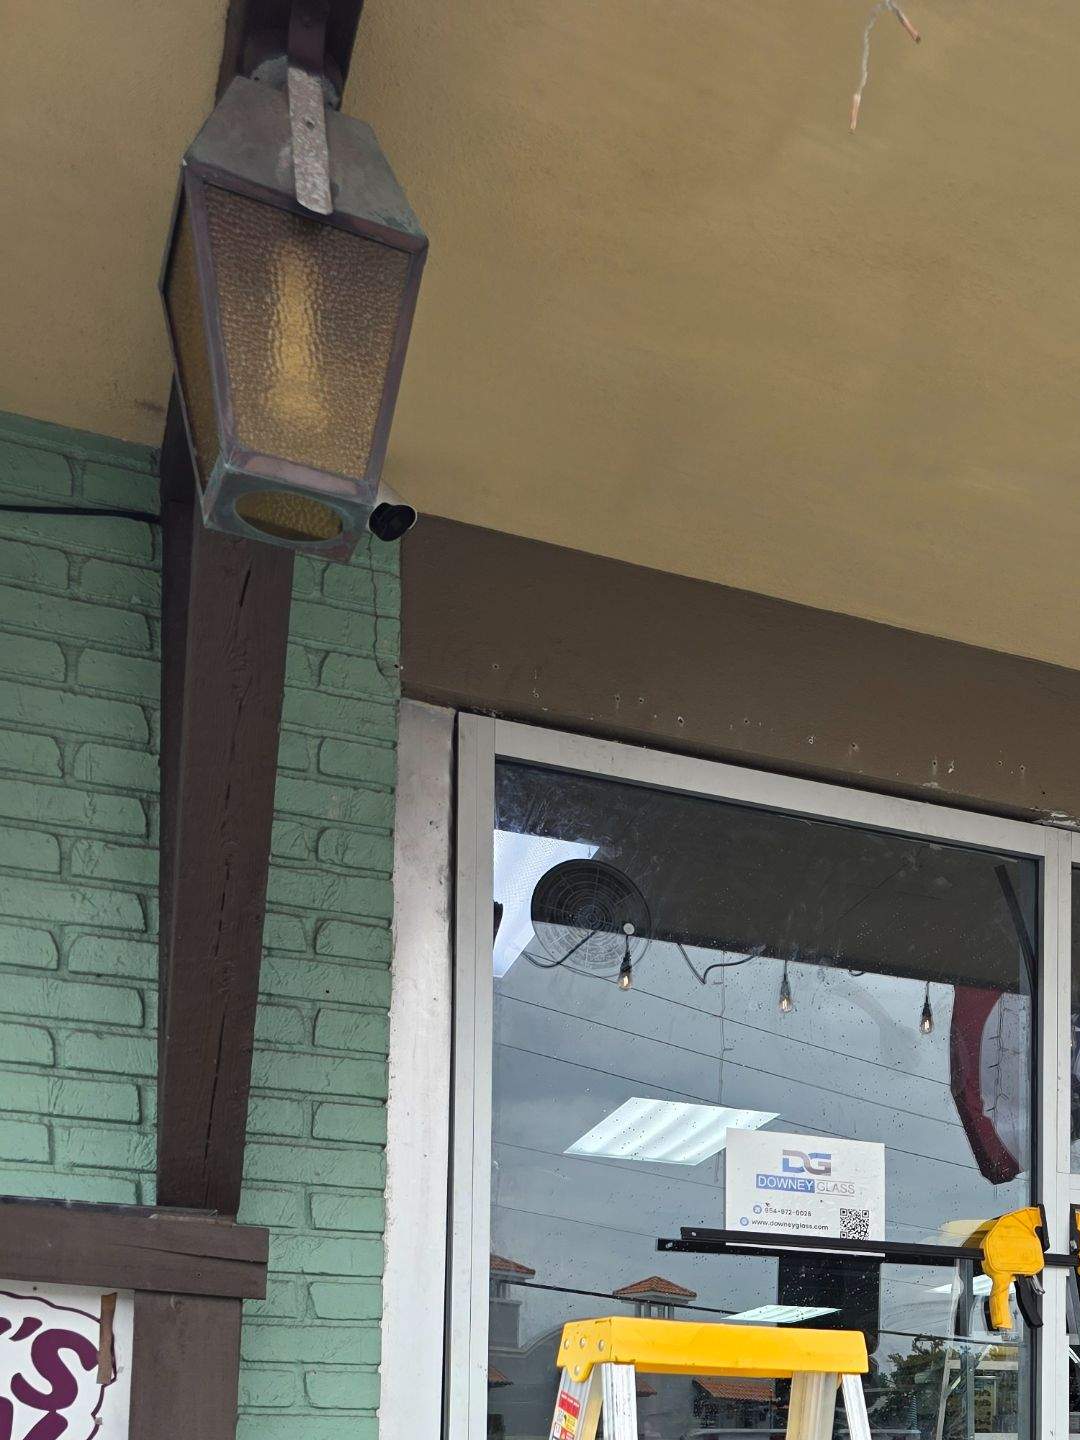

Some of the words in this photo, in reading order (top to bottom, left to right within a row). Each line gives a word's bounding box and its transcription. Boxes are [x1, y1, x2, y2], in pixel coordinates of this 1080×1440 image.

[757, 1174, 814, 1192] DOWNEY
[817, 1181, 855, 1195] GLASS
[751, 1218, 829, 1231] www.downeyglass.com
